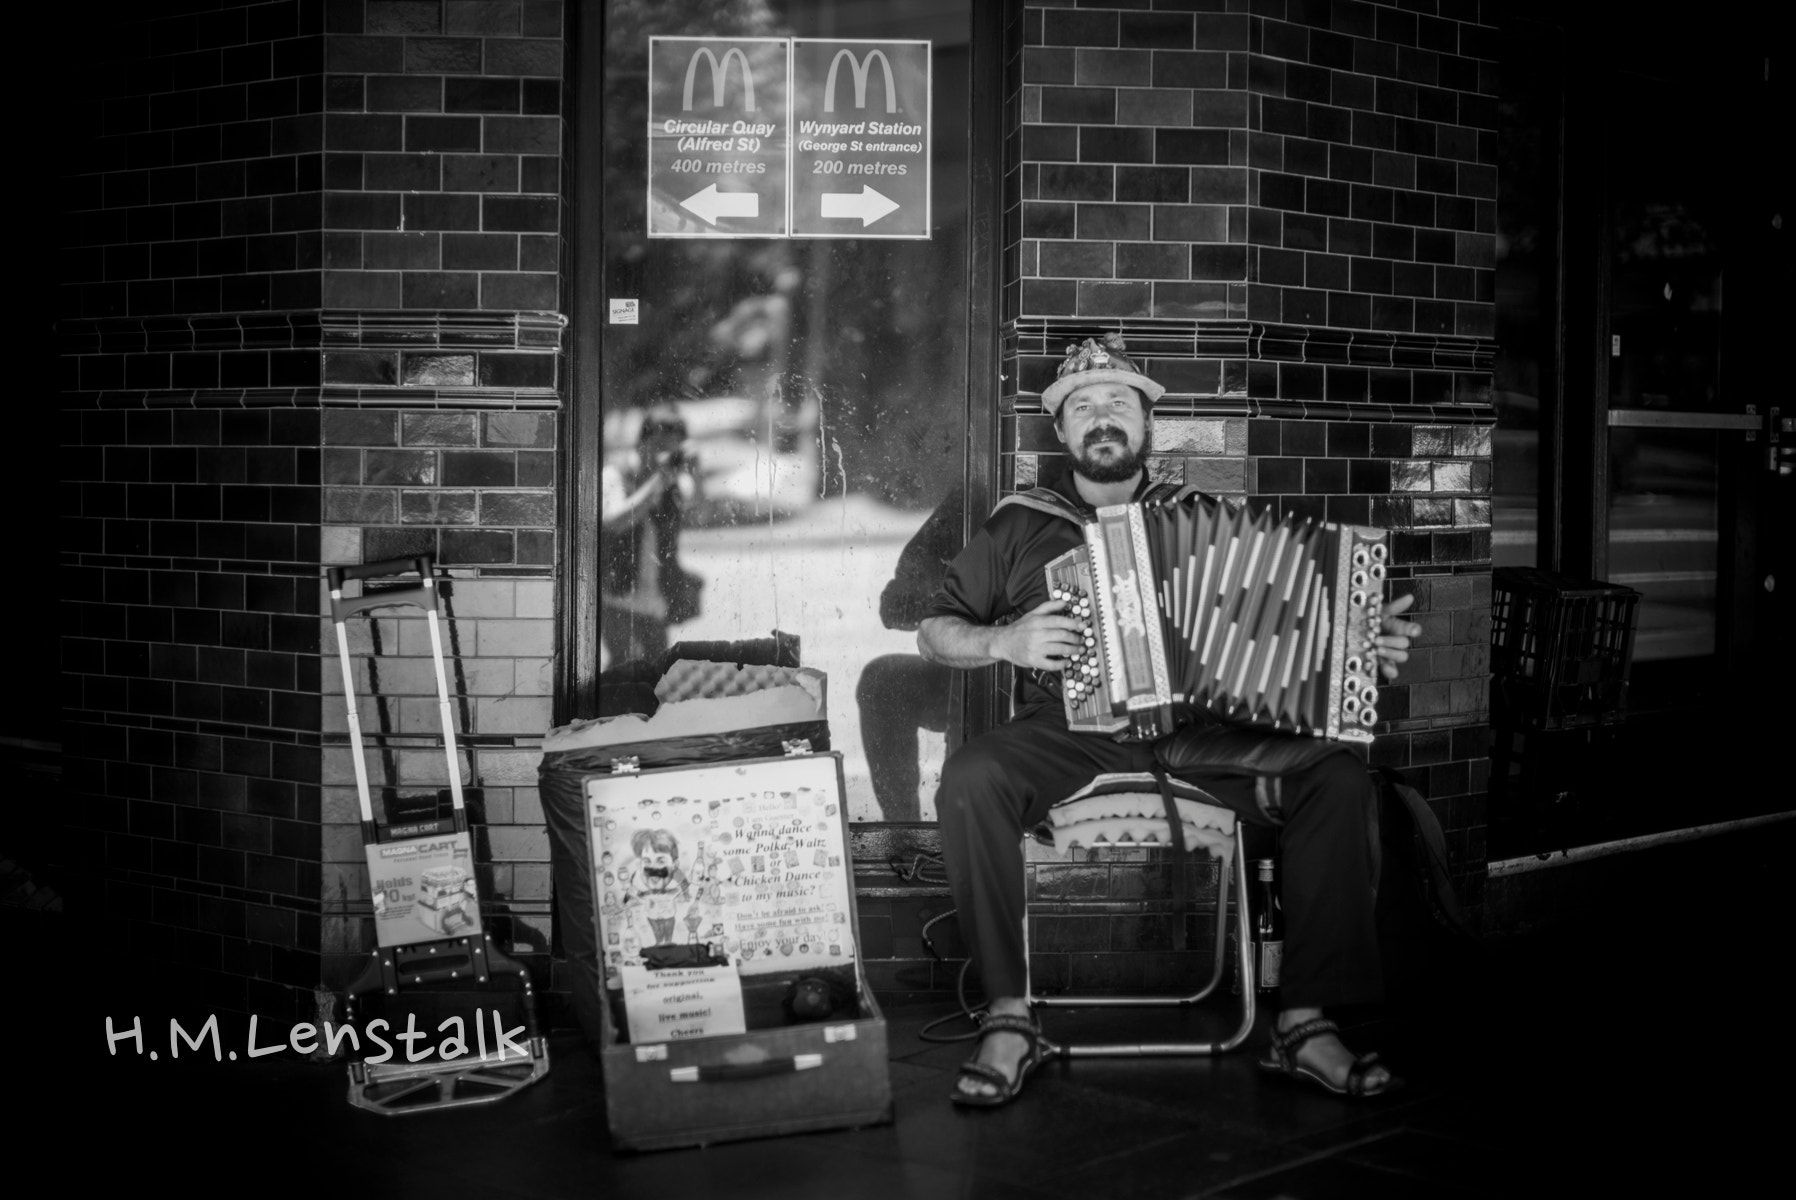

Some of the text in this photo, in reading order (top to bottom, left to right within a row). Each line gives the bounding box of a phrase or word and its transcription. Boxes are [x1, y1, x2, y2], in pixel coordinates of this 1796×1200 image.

[663, 119, 776, 138] Circular Quay
[799, 120, 922, 137] Wynyard Station
[677, 136, 761, 154] (Alfred St)
[798, 140, 923, 154] (George St entrance)
[670, 159, 767, 174] 400 metres
[812, 160, 908, 176] 200 metres
[390, 822, 439, 838] MAGNA CART
[778, 824, 812, 836] dance
[382, 839, 457, 857] MAGNA CART
[723, 847, 751, 857] some
[795, 836, 827, 849] Waltz
[769, 859, 782, 869] or
[375, 876, 413, 891] Holds
[734, 870, 821, 887] Chicken Dance
[741, 884, 816, 903] to my music?
[775, 936, 800, 949] your
[654, 969, 705, 978] Thank you
[658, 1007, 712, 1023] live music!
[670, 1028, 705, 1039] Cheers
